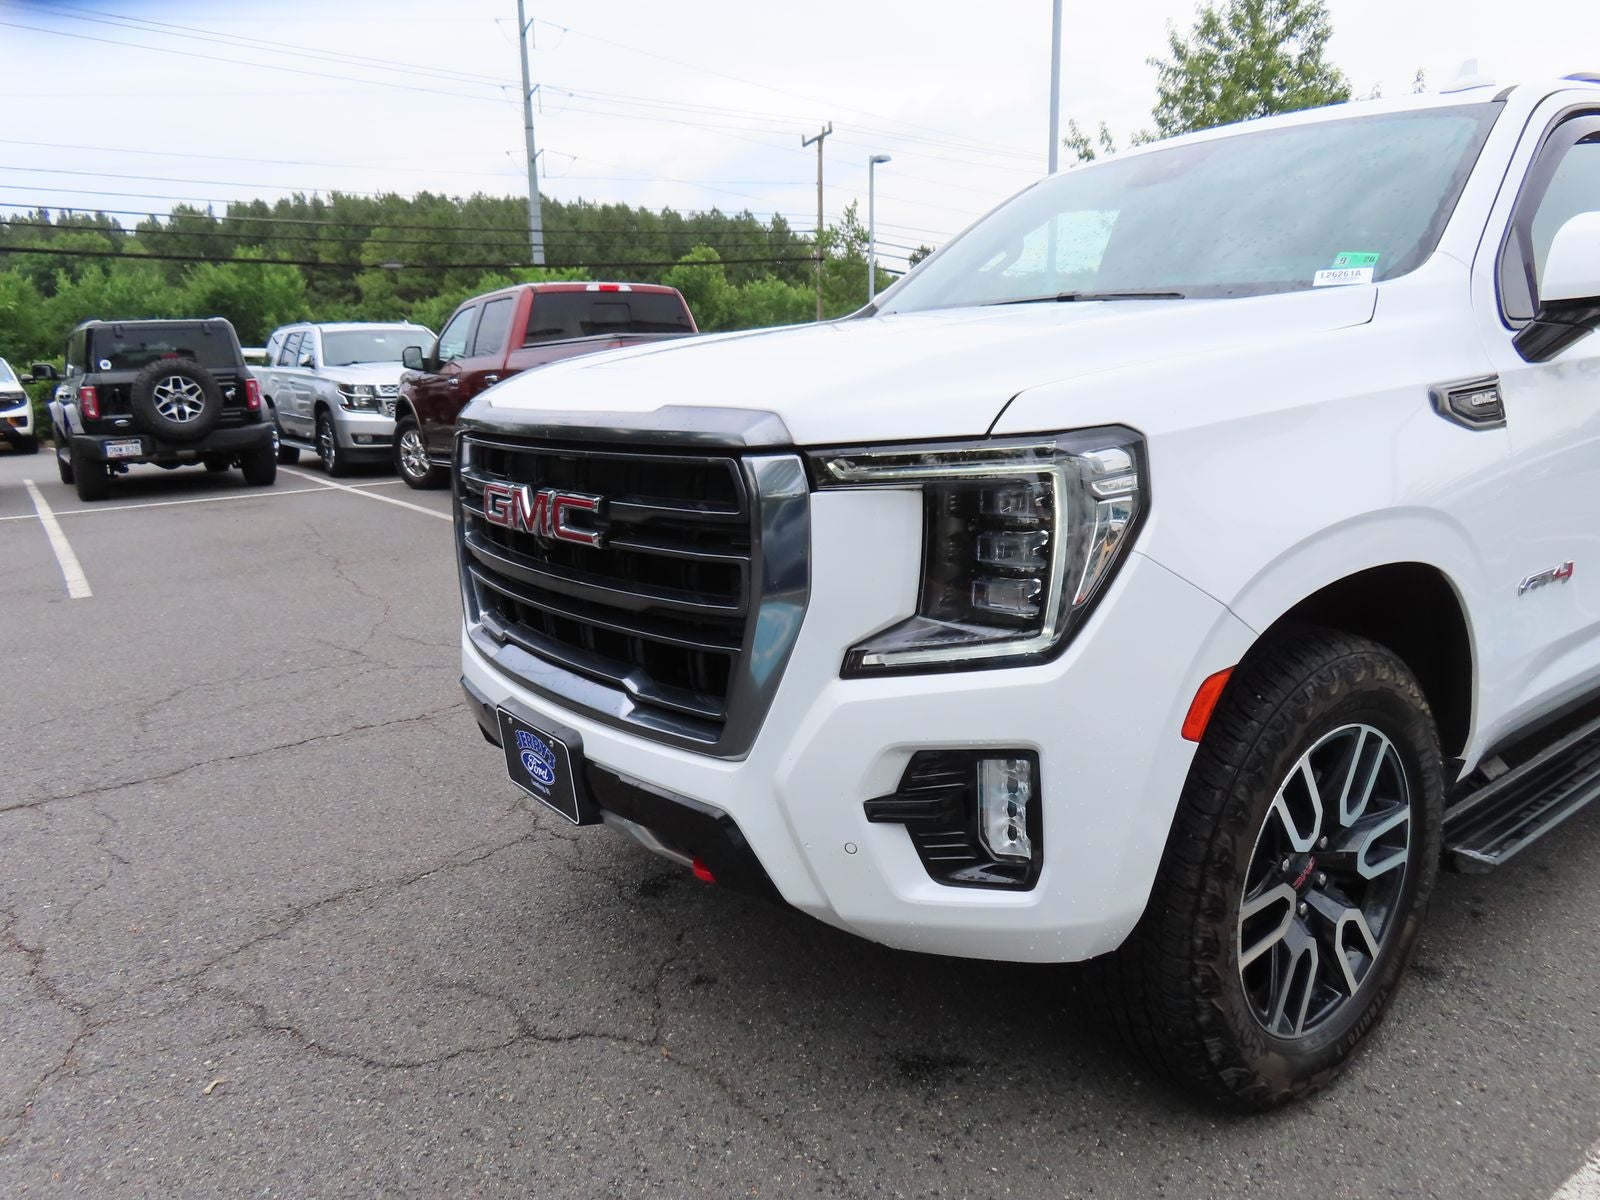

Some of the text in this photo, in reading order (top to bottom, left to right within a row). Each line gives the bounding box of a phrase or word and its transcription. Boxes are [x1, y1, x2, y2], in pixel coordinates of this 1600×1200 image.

[1471, 390, 1498, 406] GMC
[484, 482, 603, 549] GMC
[528, 755, 549, 781] Ford
